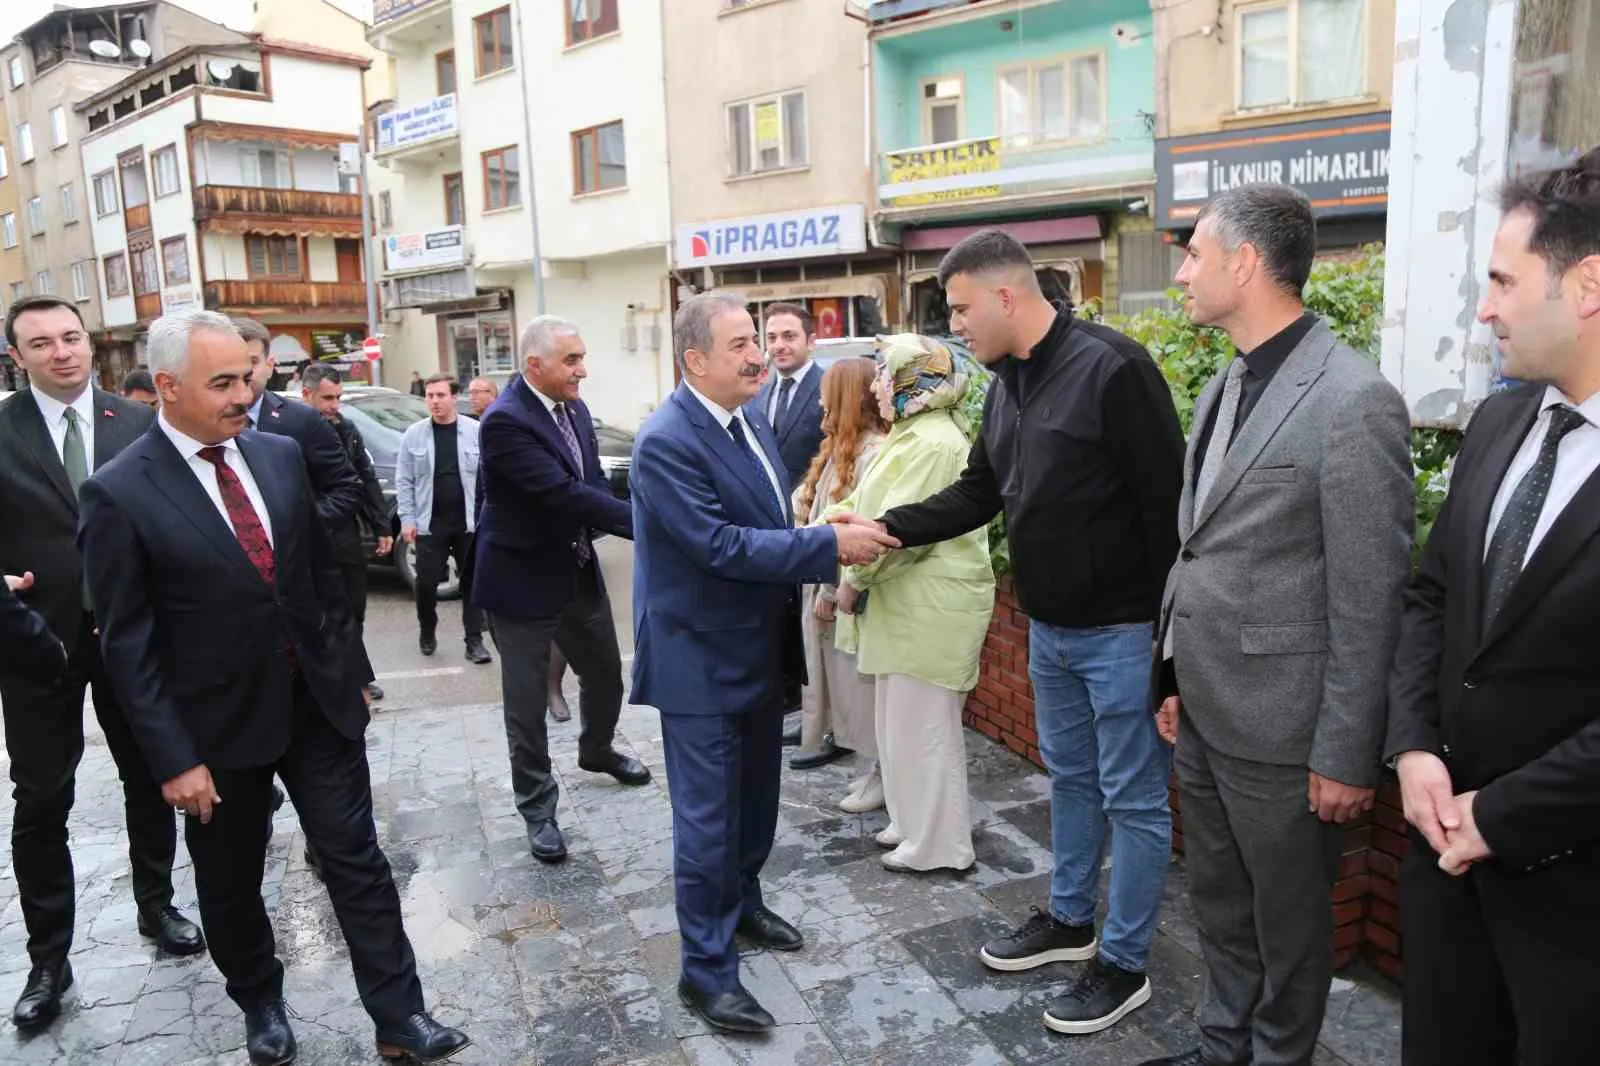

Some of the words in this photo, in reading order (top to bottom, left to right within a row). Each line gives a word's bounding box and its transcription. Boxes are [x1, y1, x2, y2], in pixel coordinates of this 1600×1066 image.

[890, 139, 995, 169] SATILIK
[1212, 159, 1284, 192] İLKNUR
[1289, 148, 1390, 185] MİMARLIK
